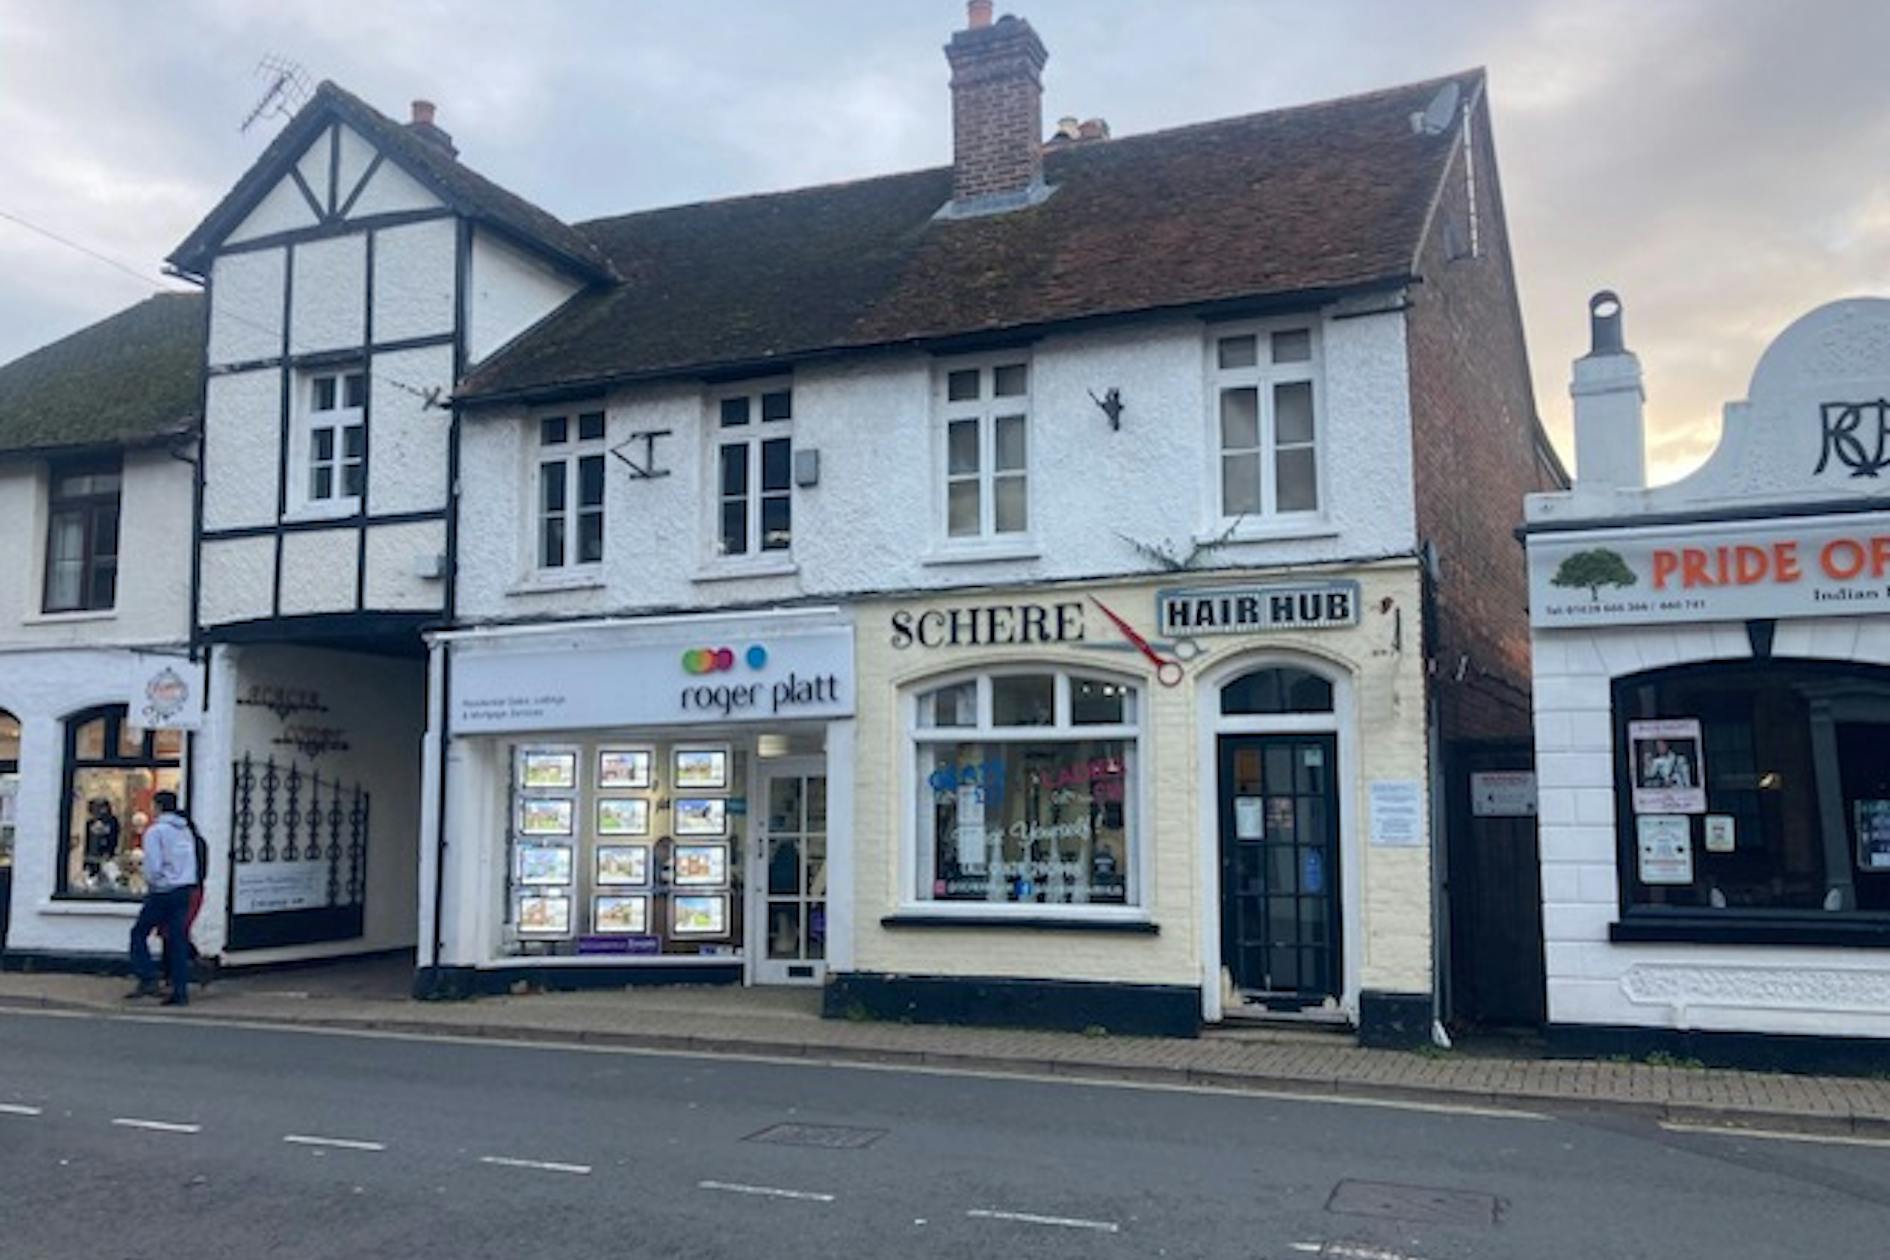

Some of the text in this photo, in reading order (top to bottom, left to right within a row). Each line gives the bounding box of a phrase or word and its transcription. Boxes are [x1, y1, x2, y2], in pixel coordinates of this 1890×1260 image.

[1652, 535, 1890, 591] PRIDE OF
[1168, 593, 1350, 626] HAIR HUB
[1813, 587, 1879, 601] Indian
[891, 602, 1085, 650] SCHERE
[682, 671, 839, 715] roger platt
